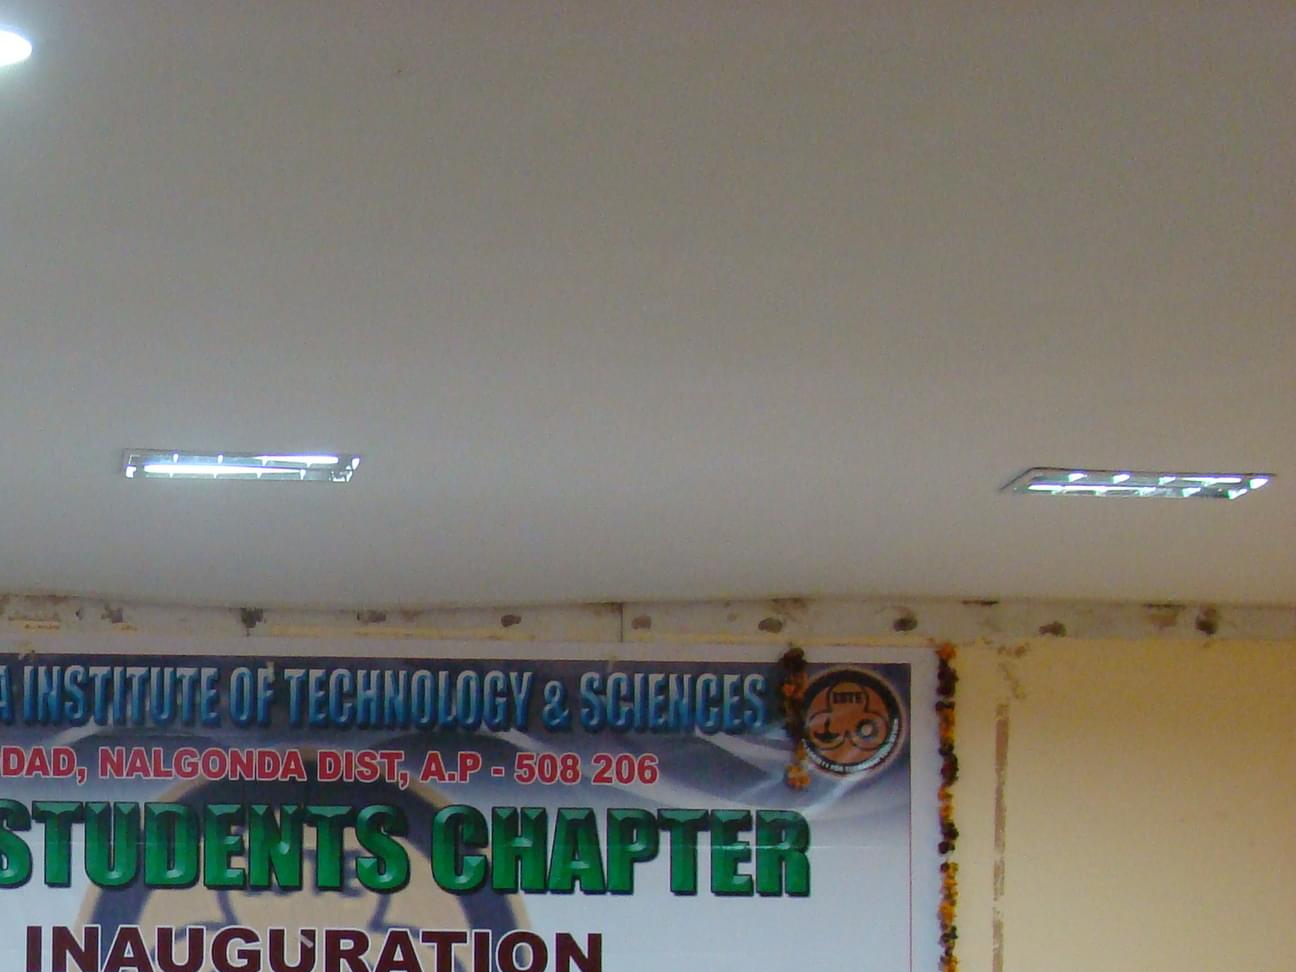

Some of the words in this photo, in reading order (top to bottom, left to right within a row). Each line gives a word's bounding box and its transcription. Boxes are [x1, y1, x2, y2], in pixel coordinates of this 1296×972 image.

[23, 665, 223, 727] INSTITUTE
[229, 667, 276, 728] OF
[284, 668, 533, 731] TECHNOLOGY
[543, 680, 569, 728] &
[580, 671, 767, 732] SCIENCES
[98, 748, 306, 781] NALGONDA
[317, 750, 410, 788] DIST,
[419, 750, 482, 784] A.P
[515, 752, 581, 785] 508
[592, 753, 660, 785] 206
[431, 803, 812, 897] CHAPTER
